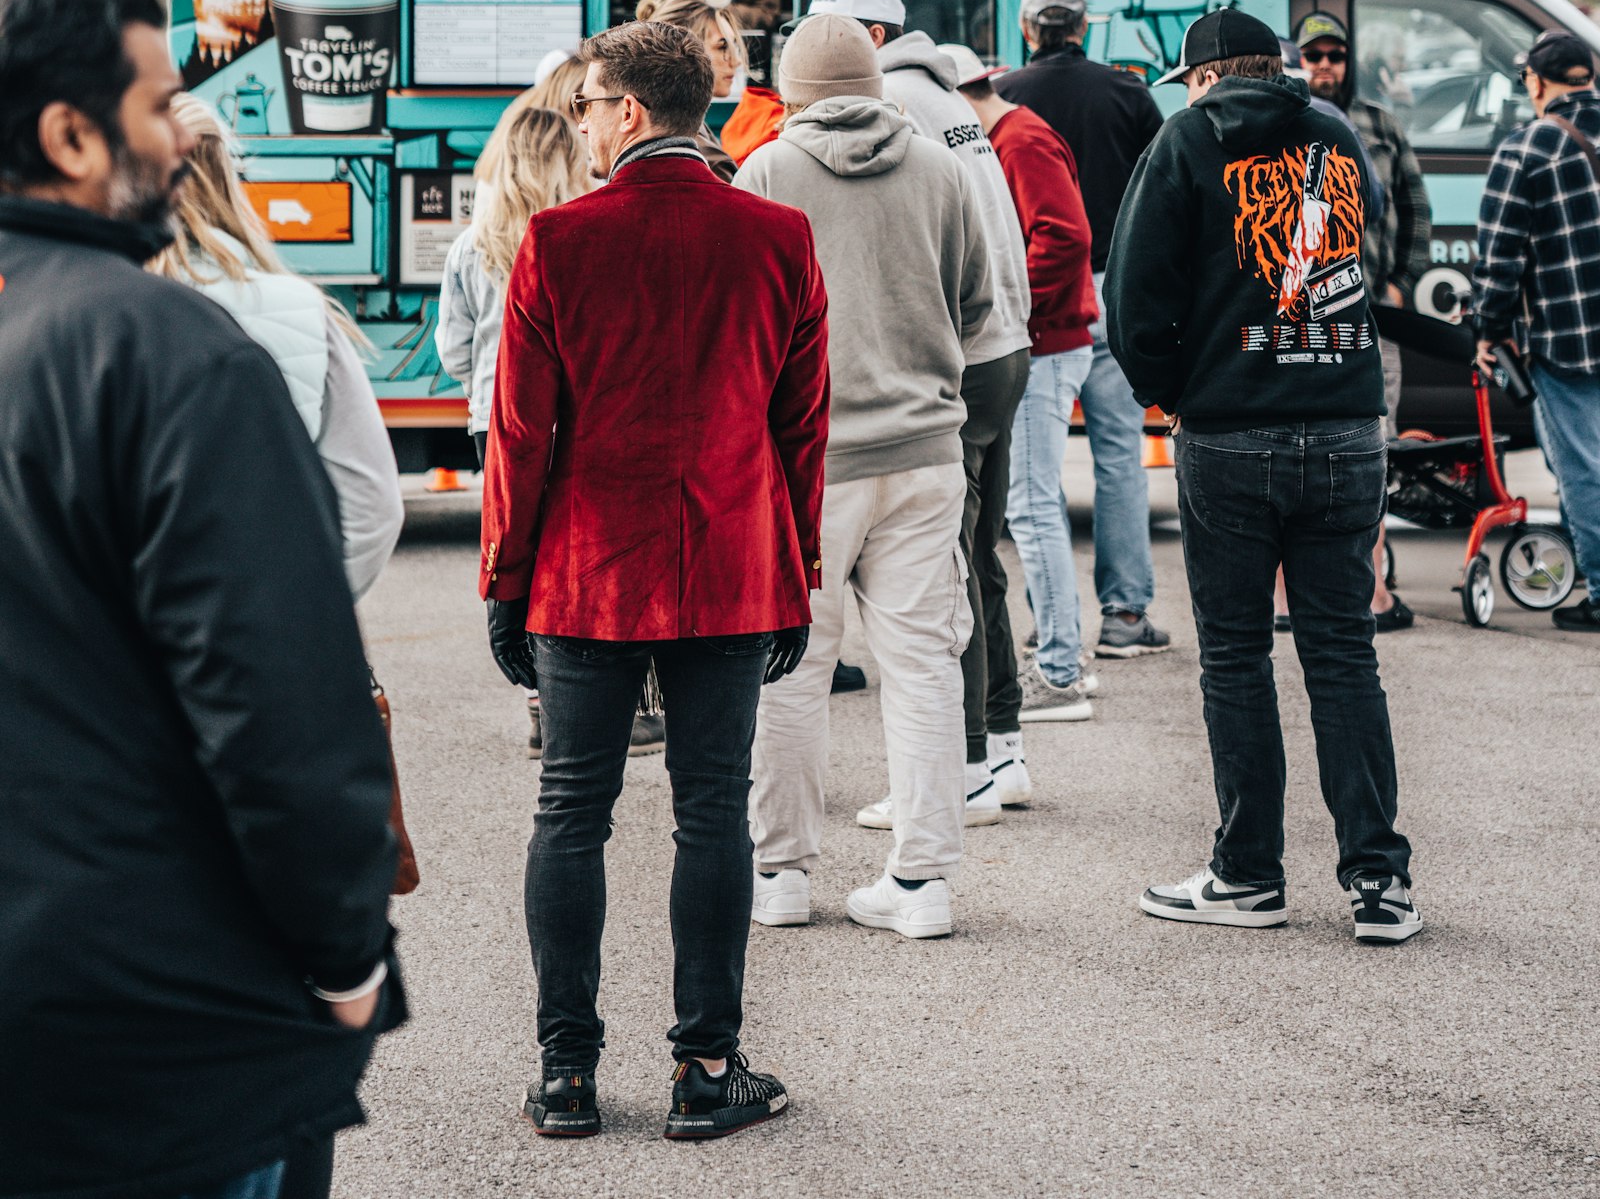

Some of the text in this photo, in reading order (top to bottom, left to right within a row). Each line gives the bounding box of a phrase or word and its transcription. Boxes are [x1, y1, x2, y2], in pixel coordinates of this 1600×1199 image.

[284, 46, 390, 81] TOM'S
[292, 76, 383, 95] COFFEE TRUCK
[943, 123, 988, 149] ESSENTI
[1361, 881, 1380, 890] NIKE
